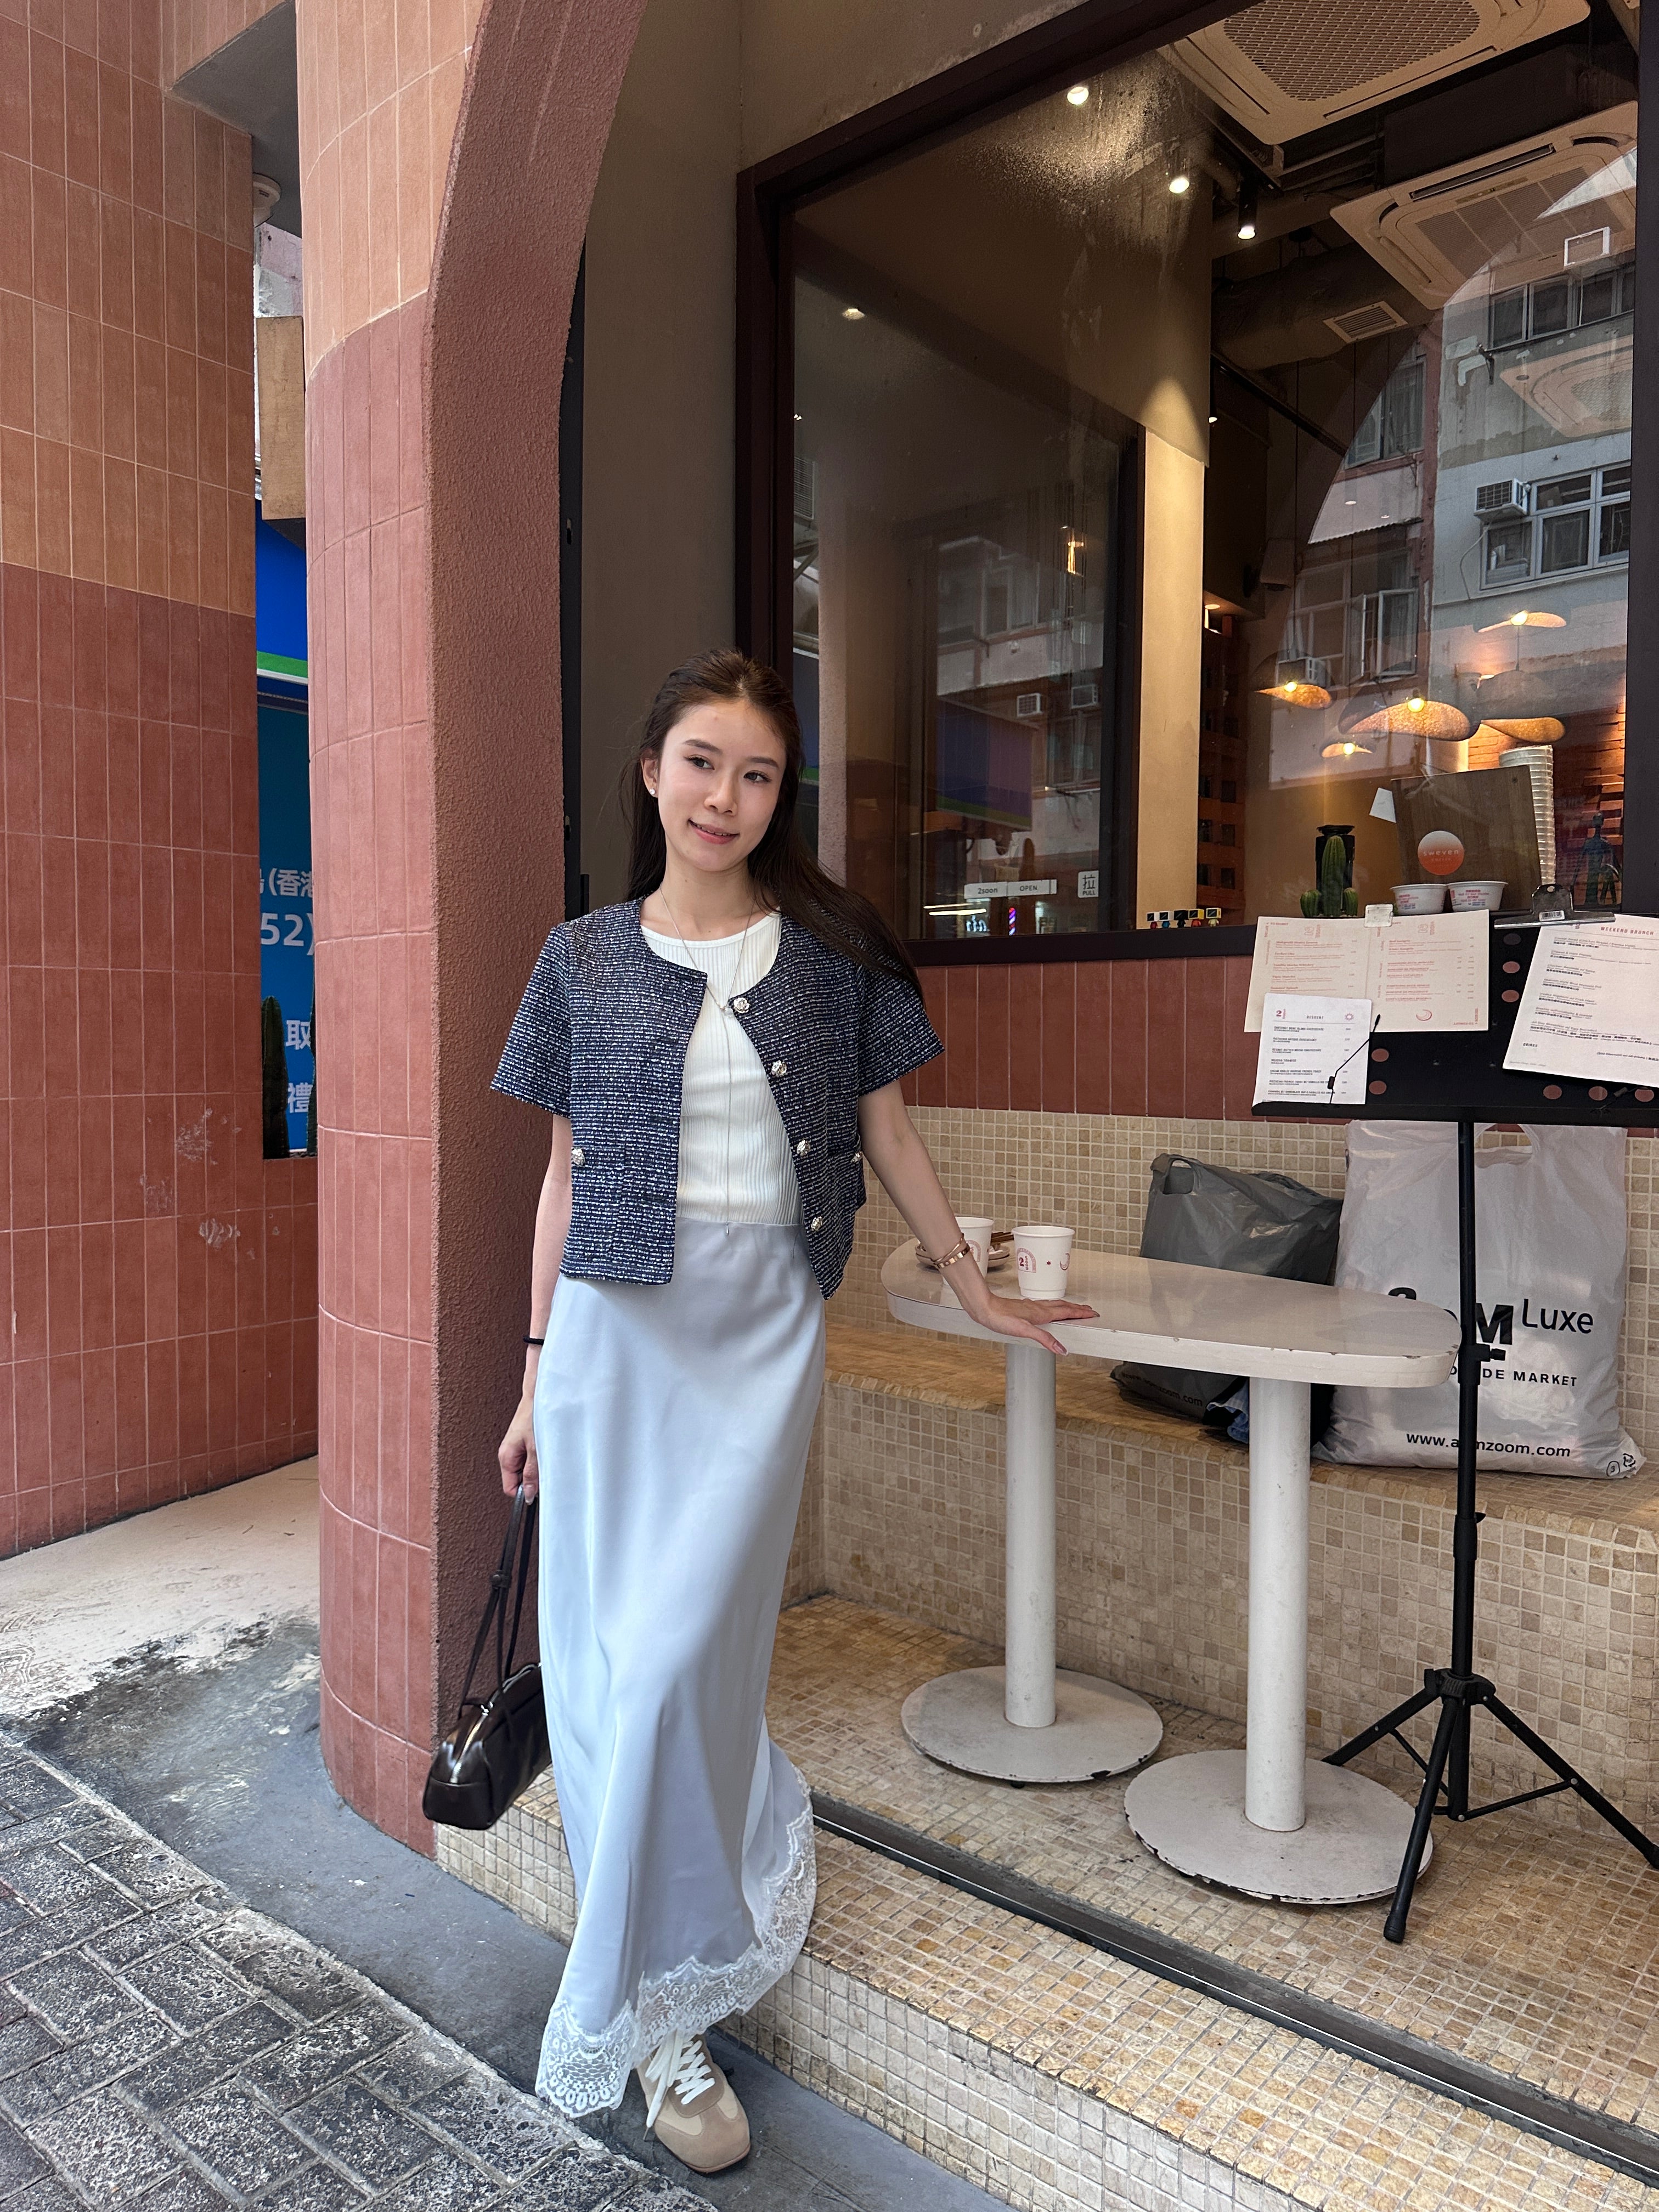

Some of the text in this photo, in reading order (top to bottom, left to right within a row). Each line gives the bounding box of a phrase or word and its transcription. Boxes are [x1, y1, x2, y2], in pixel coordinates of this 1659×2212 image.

[1082, 874, 1096, 890] 拉
[1018, 1256, 1025, 1267] 2
[1521, 1298, 1594, 1334] Luxe
[1513, 1370, 1578, 1387] MARKET
[1406, 1433, 1570, 1457] www.amzoom.com
